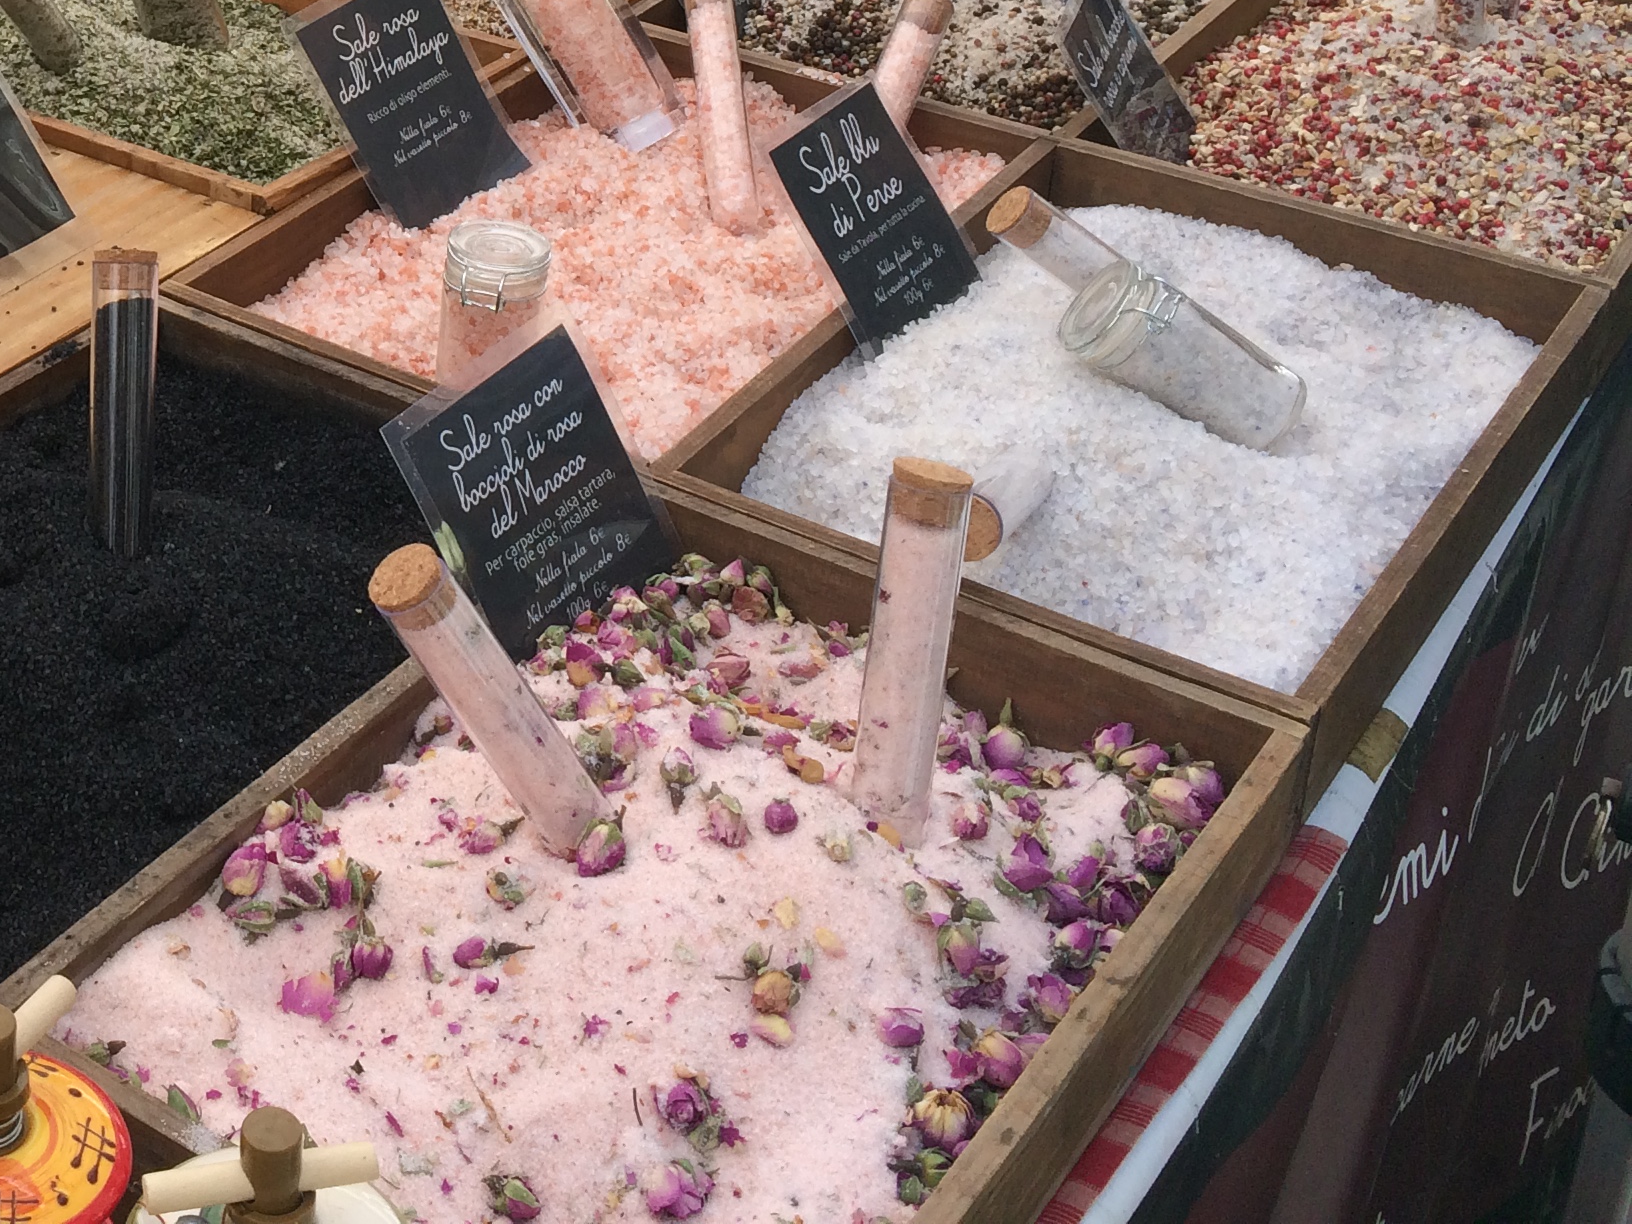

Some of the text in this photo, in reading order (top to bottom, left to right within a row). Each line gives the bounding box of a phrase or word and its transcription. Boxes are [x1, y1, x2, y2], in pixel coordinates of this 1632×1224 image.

[331, 6, 420, 62] Sale rosa
[366, 105, 389, 125] Ricco
[438, 104, 453, 119] 6€
[458, 109, 474, 125] 8€
[798, 112, 881, 196] Sale blu
[829, 171, 904, 239] di Perse
[911, 235, 926, 251] 6€
[932, 242, 947, 258] 8€
[440, 377, 564, 473] Sale rosa con
[451, 409, 584, 514] boccioli di rosa
[490, 453, 588, 540] del Marocco
[504, 467, 618, 563] carpaccio, salsa tartara,
[512, 500, 603, 575] foie gras, insalate.
[535, 525, 607, 595] Nella fiala 6€
[526, 606, 545, 631] Nel
[577, 550, 615, 595] piccolo
[615, 531, 634, 554] 8€
[592, 579, 611, 601] 6€
